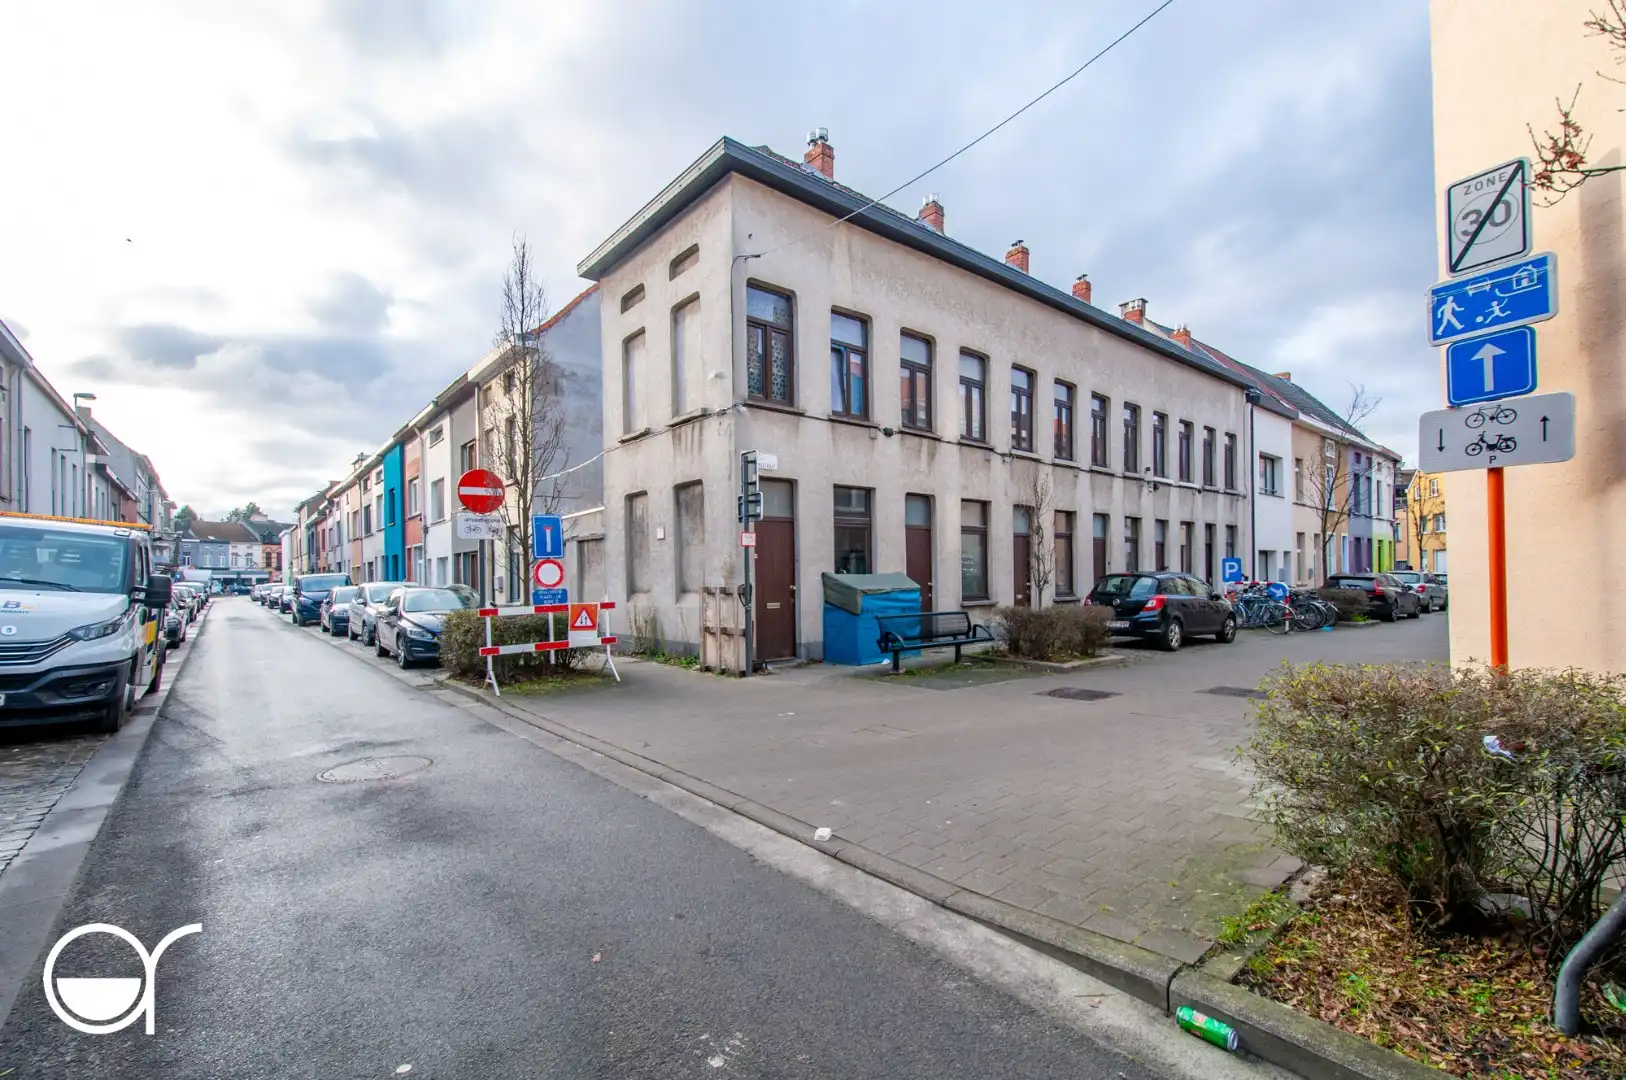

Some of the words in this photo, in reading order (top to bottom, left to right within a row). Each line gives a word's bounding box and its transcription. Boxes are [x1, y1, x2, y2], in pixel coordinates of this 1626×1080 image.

[1463, 171, 1507, 196] ZONE
[1460, 199, 1512, 237] 30
[1489, 455, 1497, 464] P
[1225, 561, 1239, 579] P
